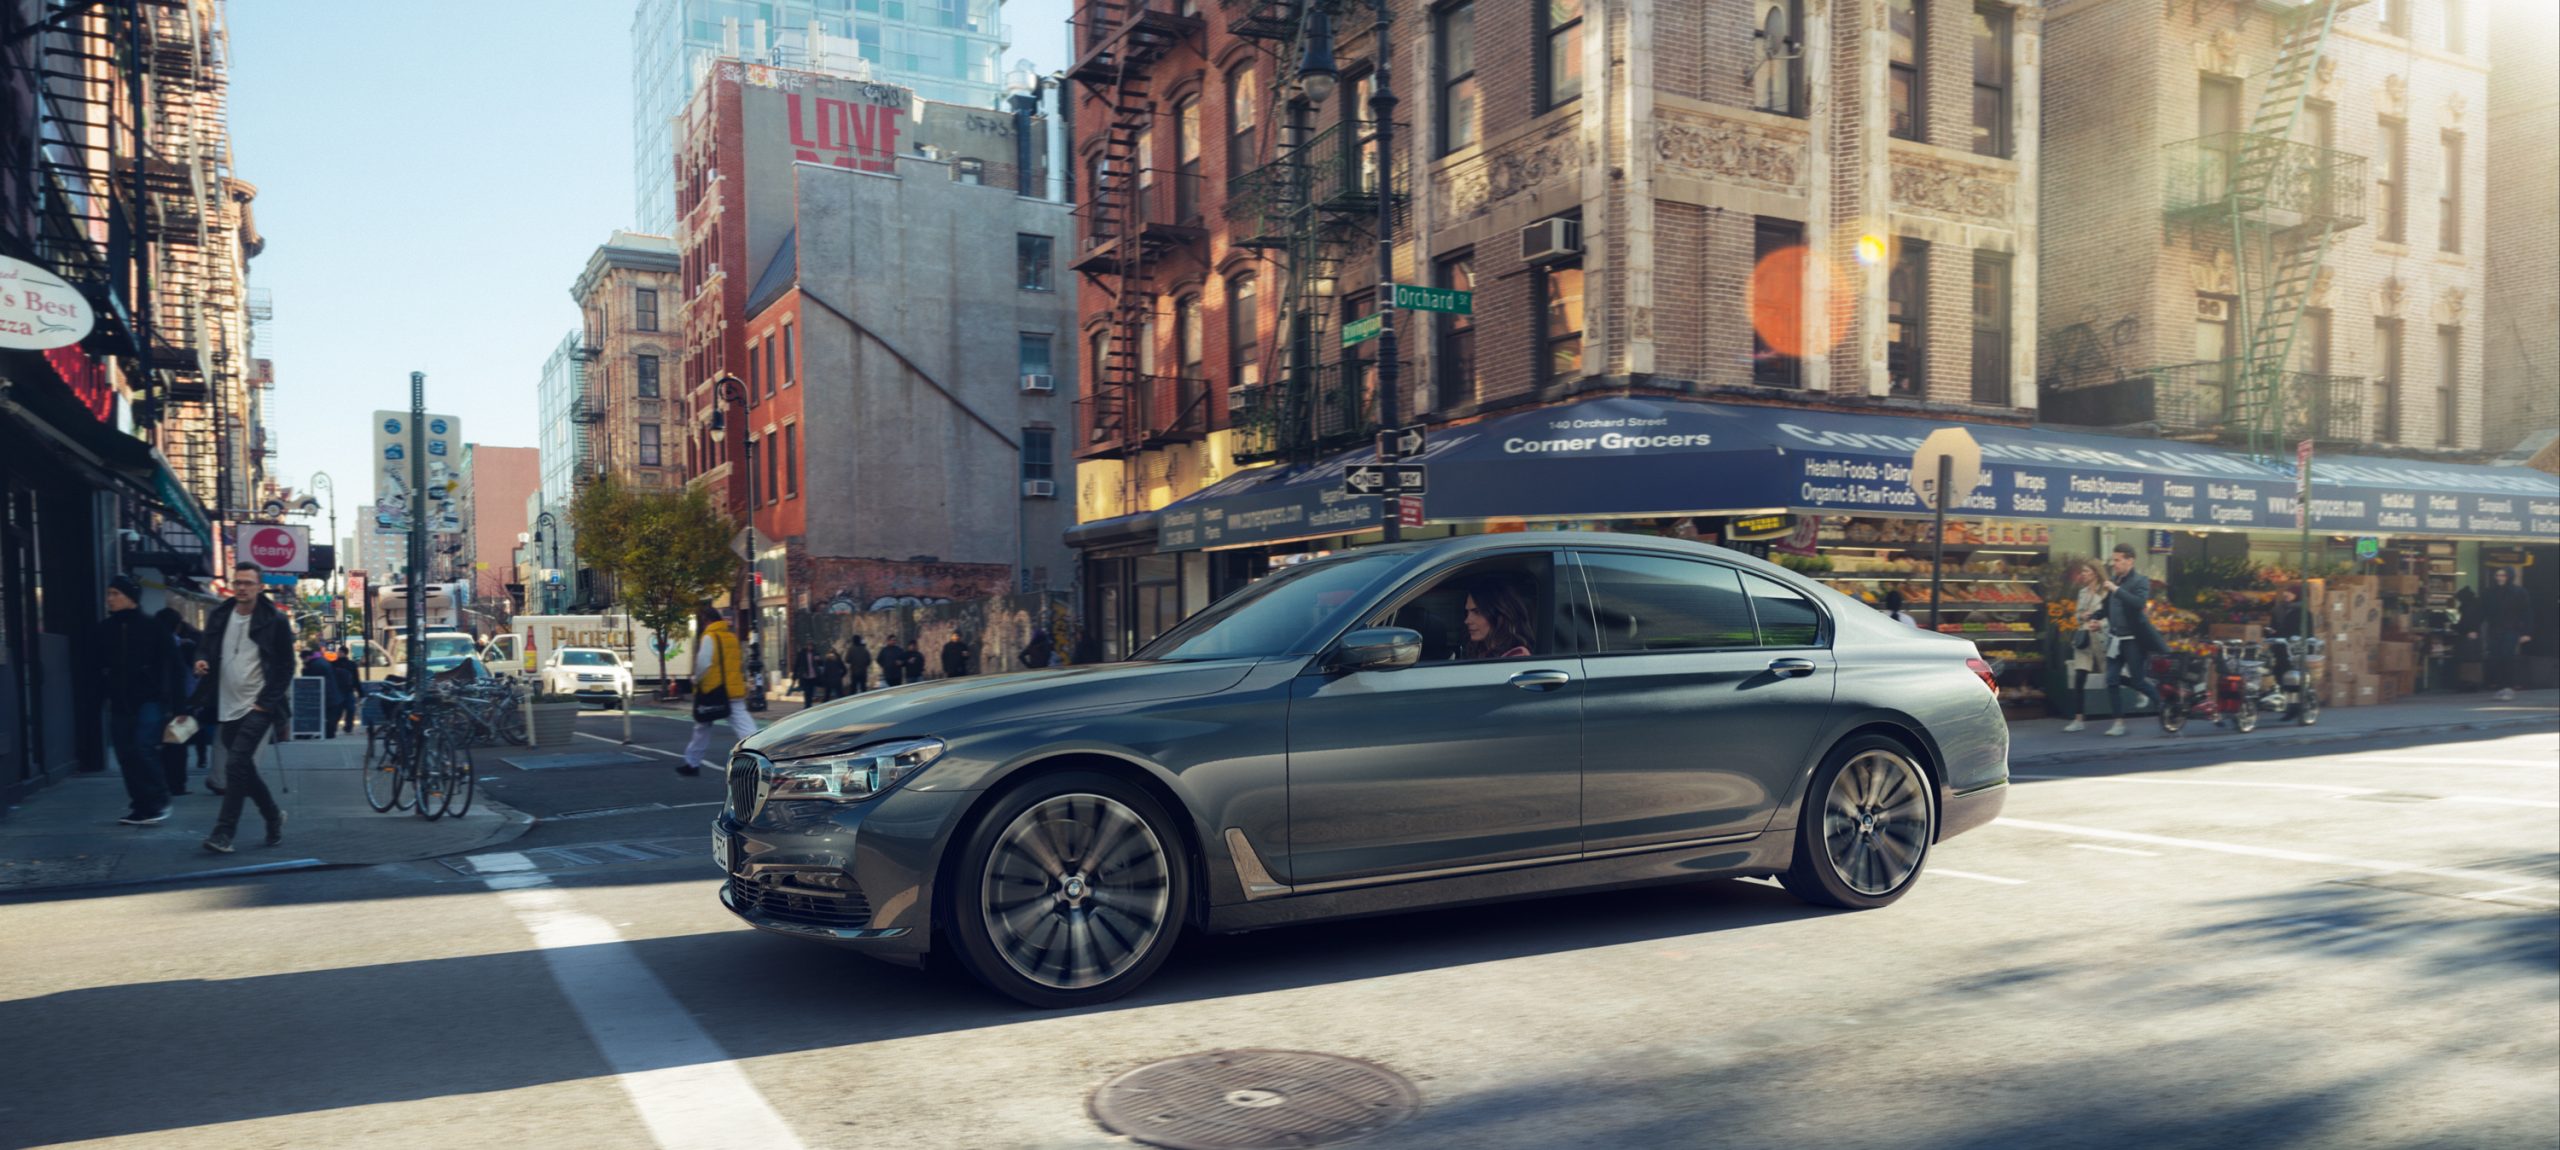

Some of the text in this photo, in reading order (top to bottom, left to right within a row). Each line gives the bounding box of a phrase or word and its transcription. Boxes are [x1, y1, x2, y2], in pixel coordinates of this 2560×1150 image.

[787, 94, 905, 158] LOVE
[24, 290, 78, 318] Best
[1399, 288, 1454, 310] Orchard
[1549, 417, 1668, 430] 140 Orchard Street
[1504, 432, 1712, 454] Corner Grocers
[1776, 423, 1926, 451] Corne
[1979, 443, 2148, 467] rocers
[1805, 458, 1843, 478] Health
[1843, 461, 1878, 479] Foods
[1354, 473, 1381, 487] ONE
[2014, 471, 2047, 493] Wraps
[1802, 482, 1847, 505] Organic
[1848, 485, 1857, 501] &
[1858, 486, 1881, 503] Raw
[1881, 488, 1917, 505] Foods
[2013, 494, 2047, 512] Salads
[251, 545, 293, 559] teany
[552, 626, 635, 650] PACIFCO
